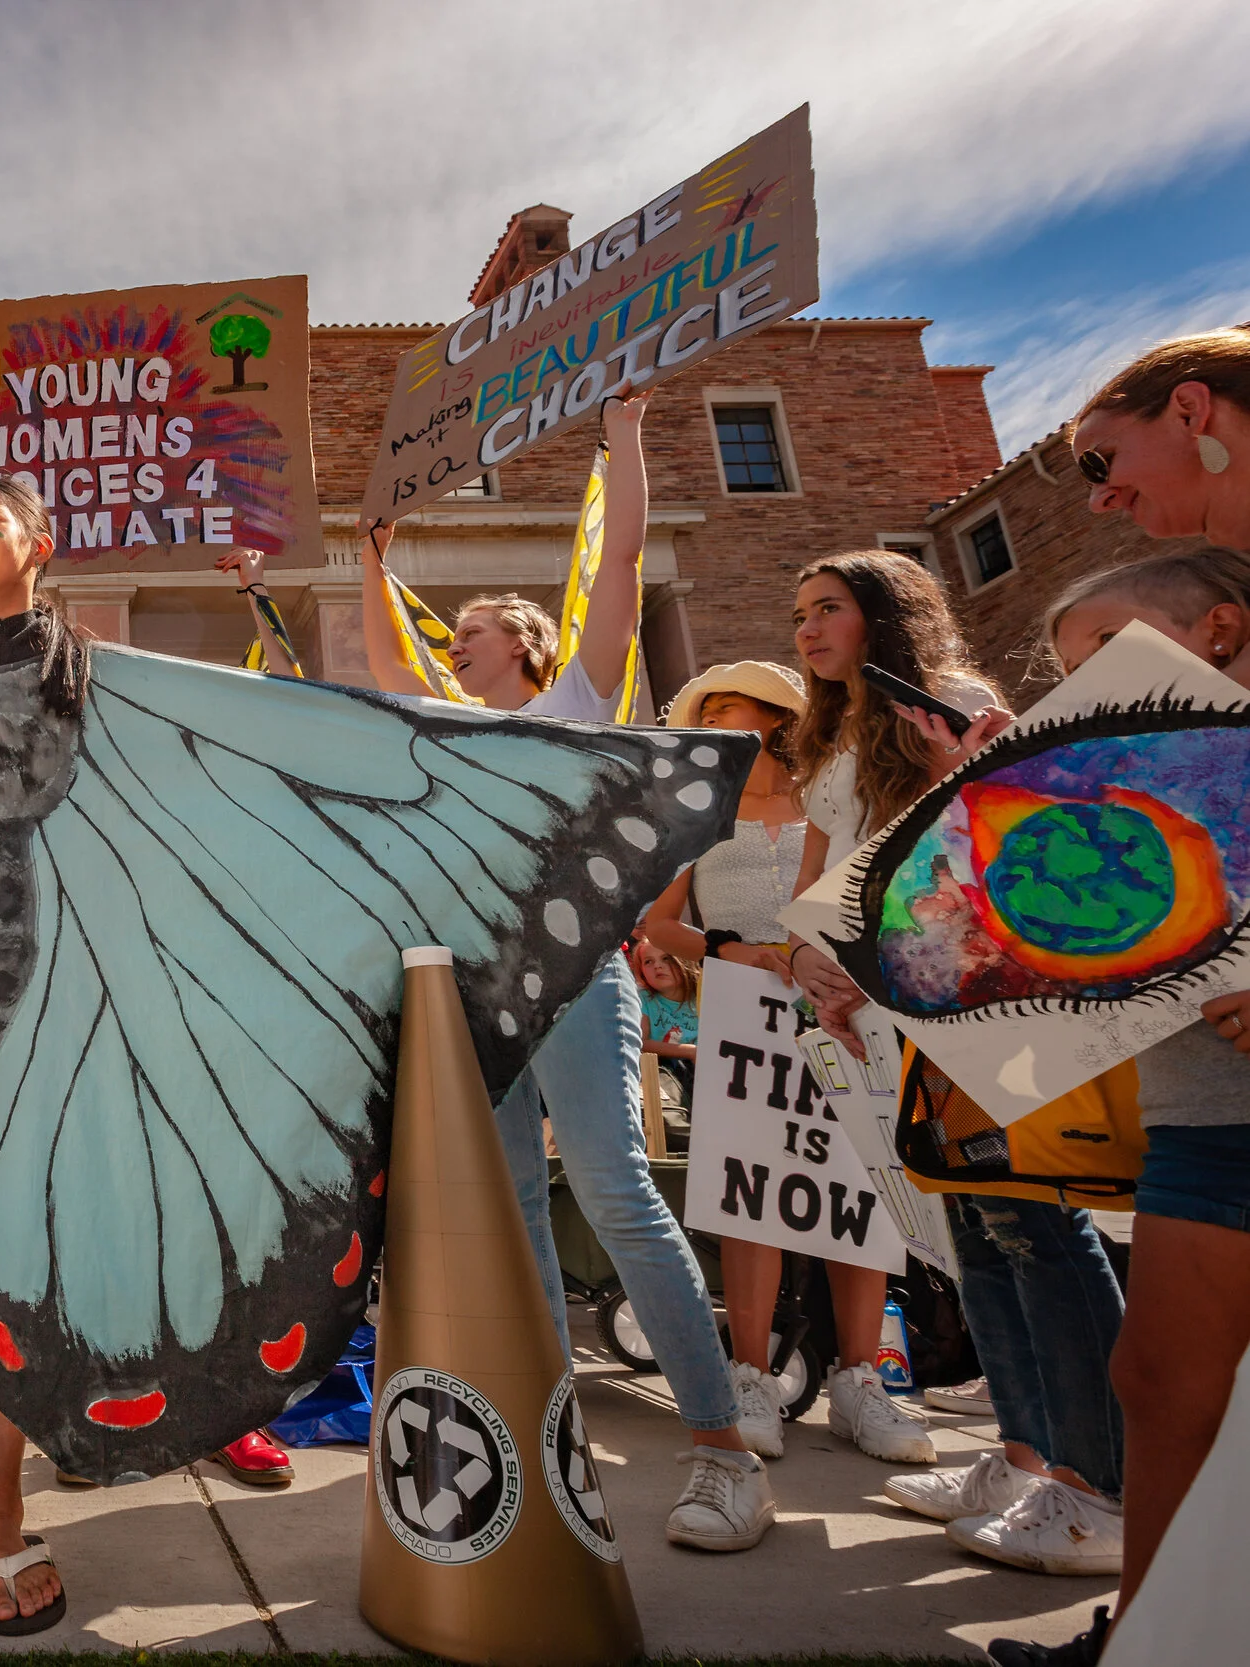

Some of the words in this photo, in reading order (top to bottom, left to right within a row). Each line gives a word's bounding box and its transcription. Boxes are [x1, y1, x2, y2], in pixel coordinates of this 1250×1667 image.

[445, 184, 686, 367] CHANGE
[472, 222, 779, 427] BEAUTIFUL
[3, 357, 172, 415] YOUNG
[393, 478, 417, 505] is
[427, 456, 467, 486] a
[478, 260, 790, 466] CHOICE
[391, 396, 472, 456] Making
[427, 427, 450, 449] it
[185, 458, 218, 499] 4
[51, 507, 234, 550] IMATE
[719, 1039, 839, 1122] TIM
[784, 1120, 831, 1165] IS
[1061, 1129, 1110, 1143] eBags
[720, 1156, 877, 1248] NOW
[545, 1374, 572, 1449] RECYCLI
[423, 1373, 513, 1456] RECYCLING
[469, 1460, 519, 1552] SERVICES
[380, 1490, 452, 1559] COLORADO
